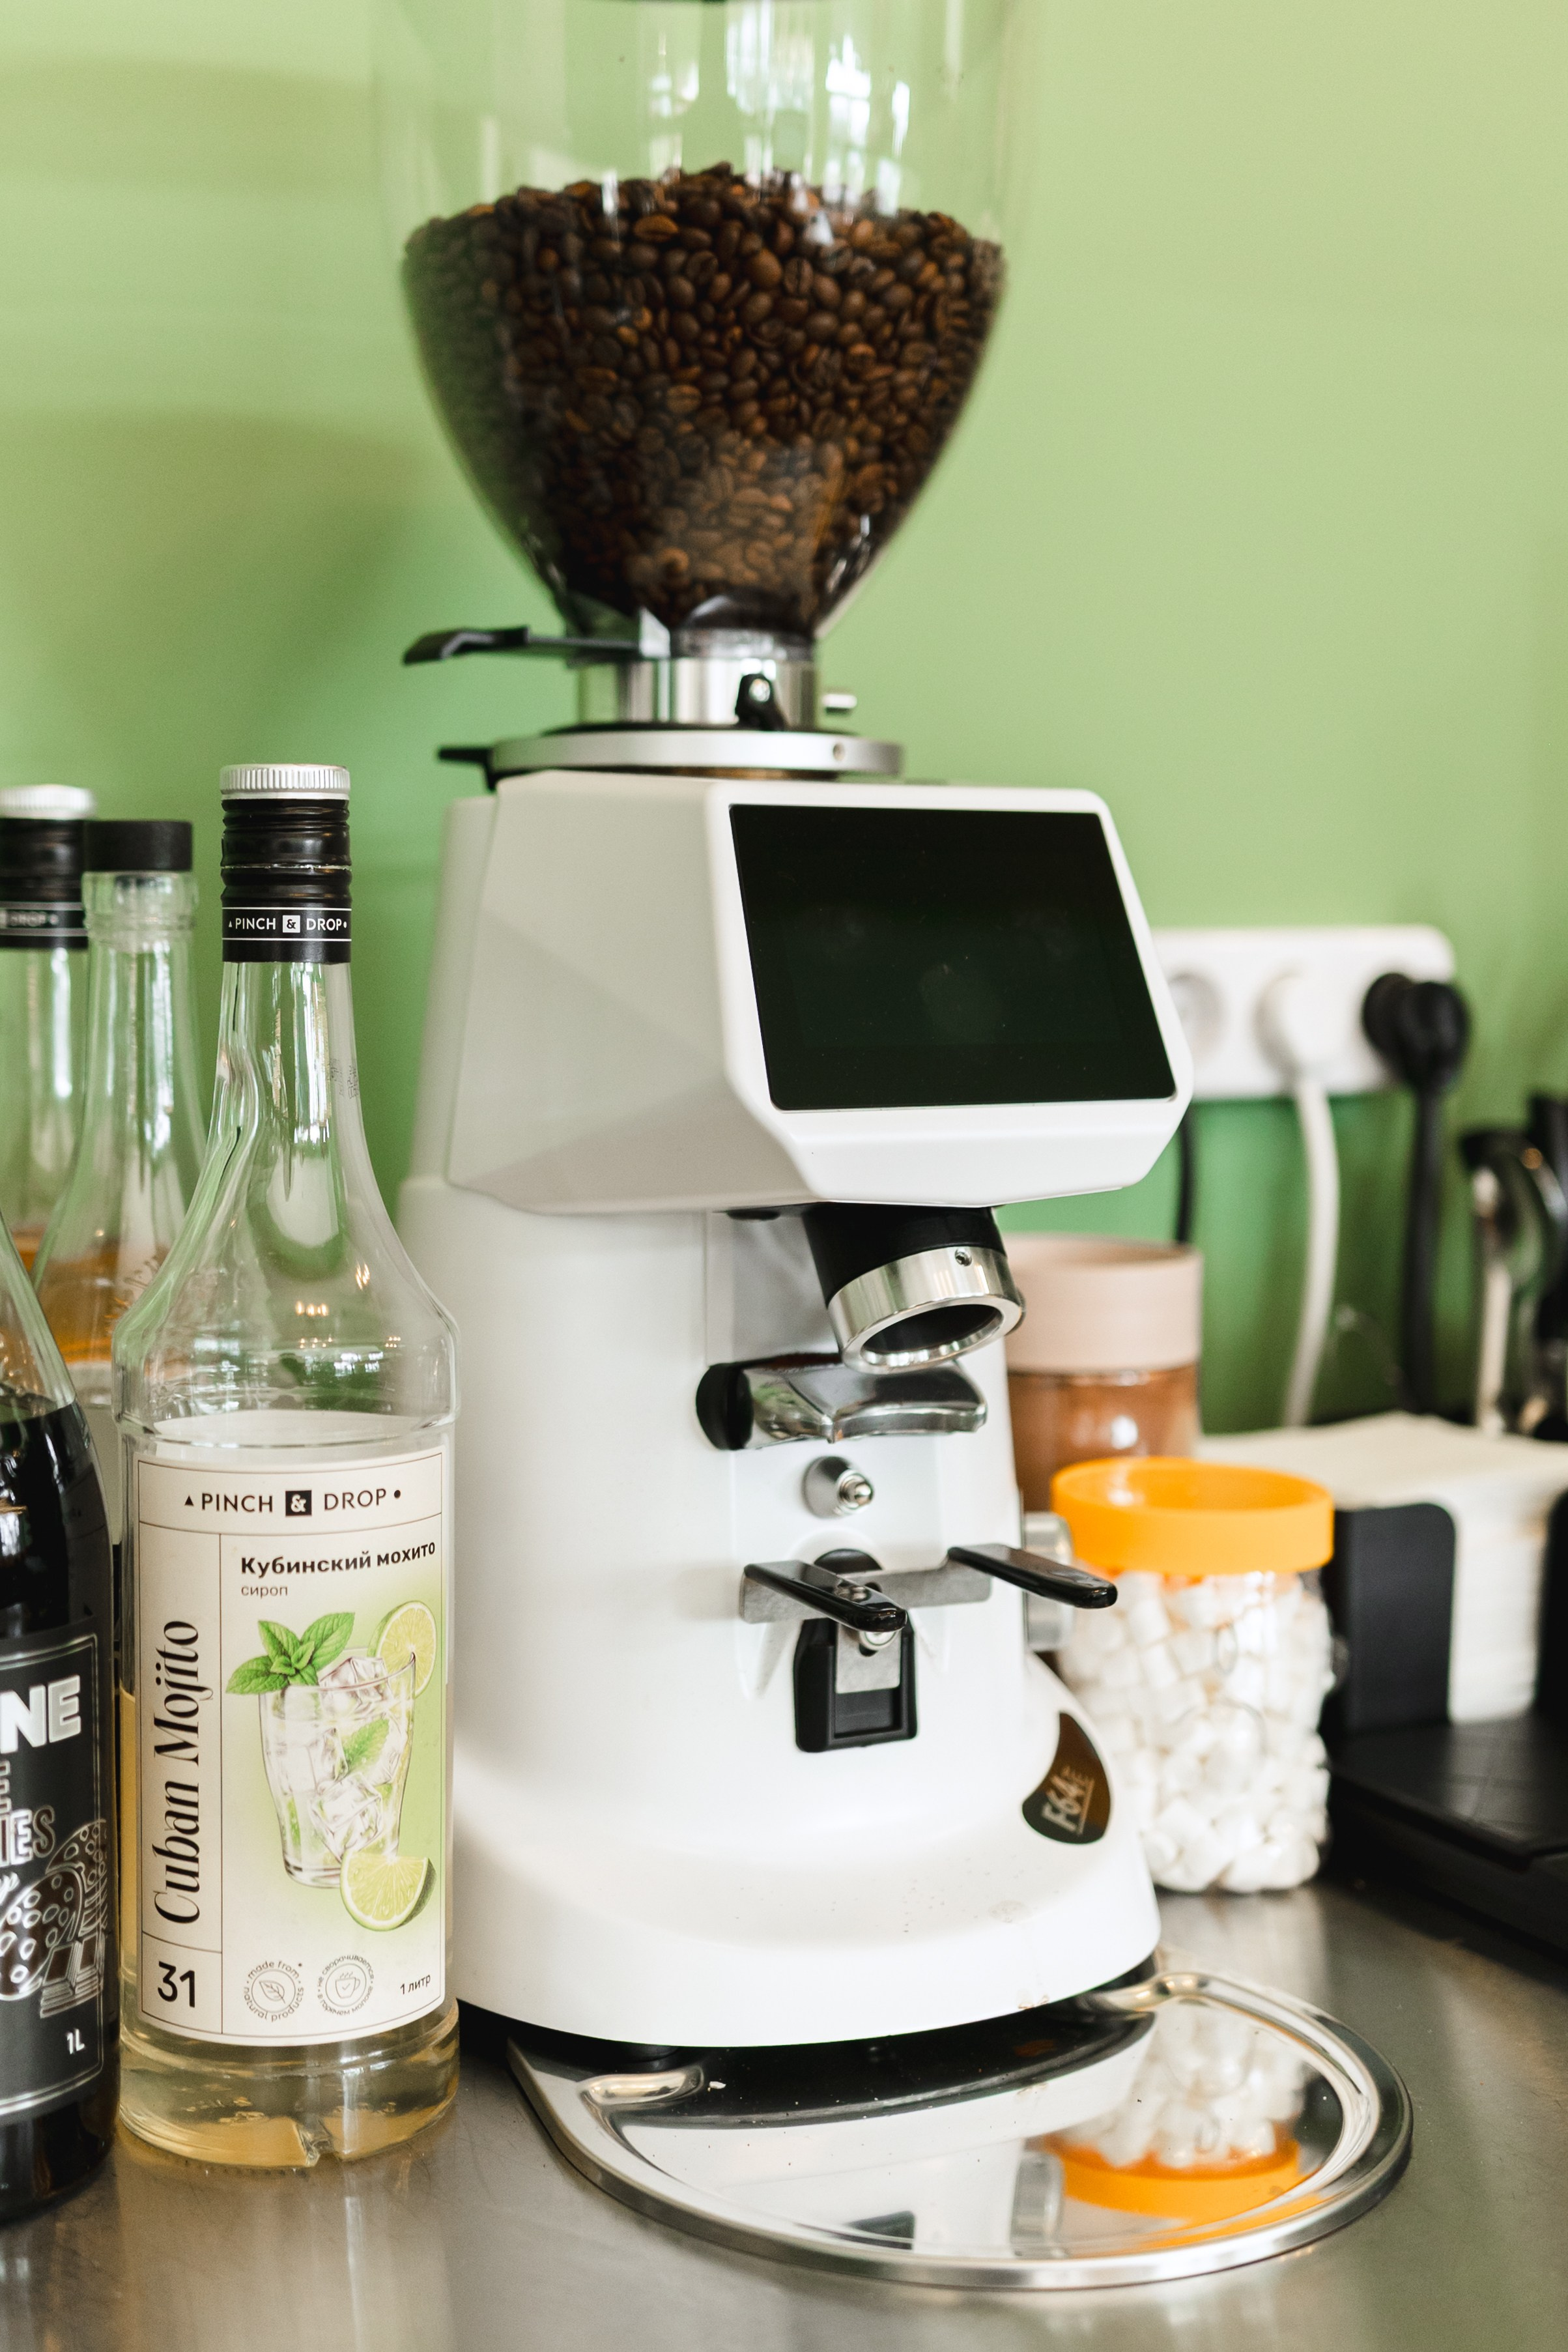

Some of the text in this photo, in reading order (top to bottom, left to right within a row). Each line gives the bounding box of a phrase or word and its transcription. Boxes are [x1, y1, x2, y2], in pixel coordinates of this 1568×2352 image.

[235, 917, 342, 931] PINCH & DROP
[201, 1488, 387, 1513] PINCH & DROP
[241, 1542, 436, 1578] Кубинский мохито
[241, 1585, 289, 1599] сироп
[152, 1620, 214, 1924] Cuban Mojito
[158, 1960, 195, 2008] 31
[244, 1960, 304, 2022] made from natural products
[400, 1974, 431, 1995] 1 литр
[66, 2028, 85, 2055] 1L
